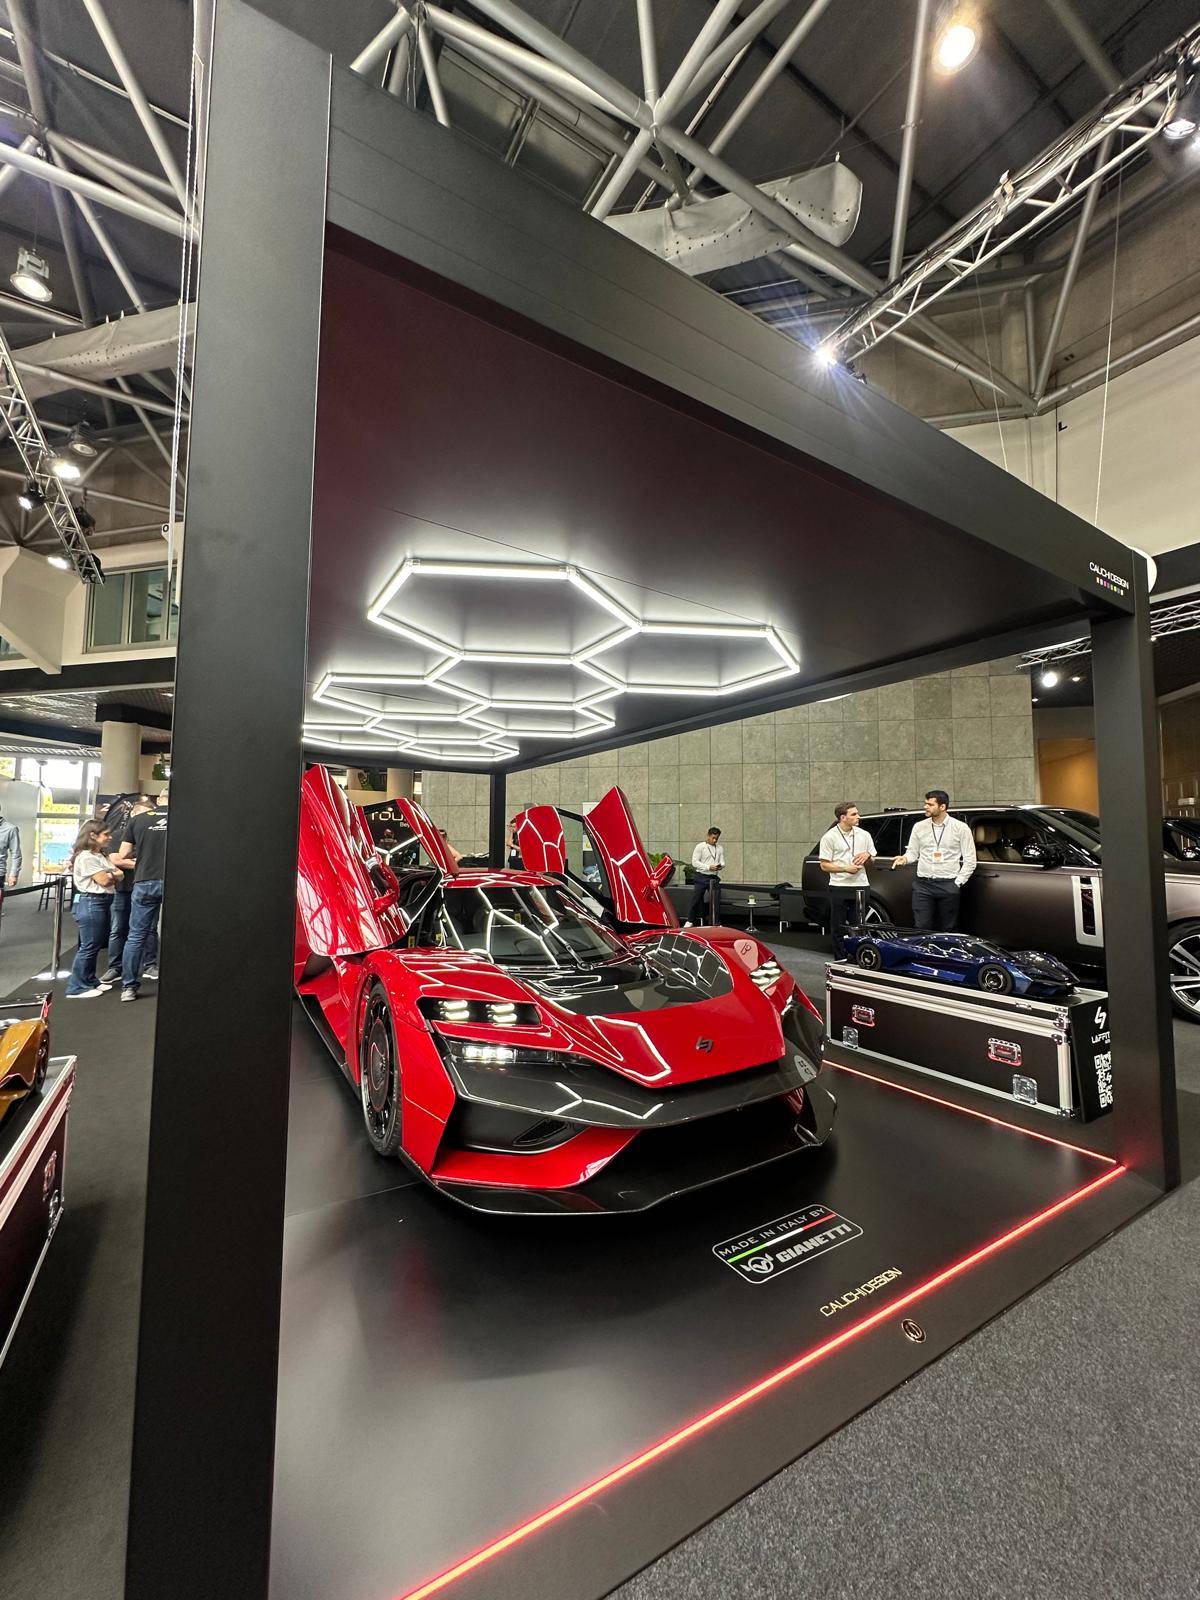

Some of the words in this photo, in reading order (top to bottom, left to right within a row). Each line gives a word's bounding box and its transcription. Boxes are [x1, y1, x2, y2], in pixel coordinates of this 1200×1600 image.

[718, 1237, 759, 1257] MADE
[760, 1229, 776, 1239] IN
[777, 1214, 808, 1232] ITALY
[809, 1207, 826, 1218] BY
[775, 1223, 853, 1263] GIANETTI
